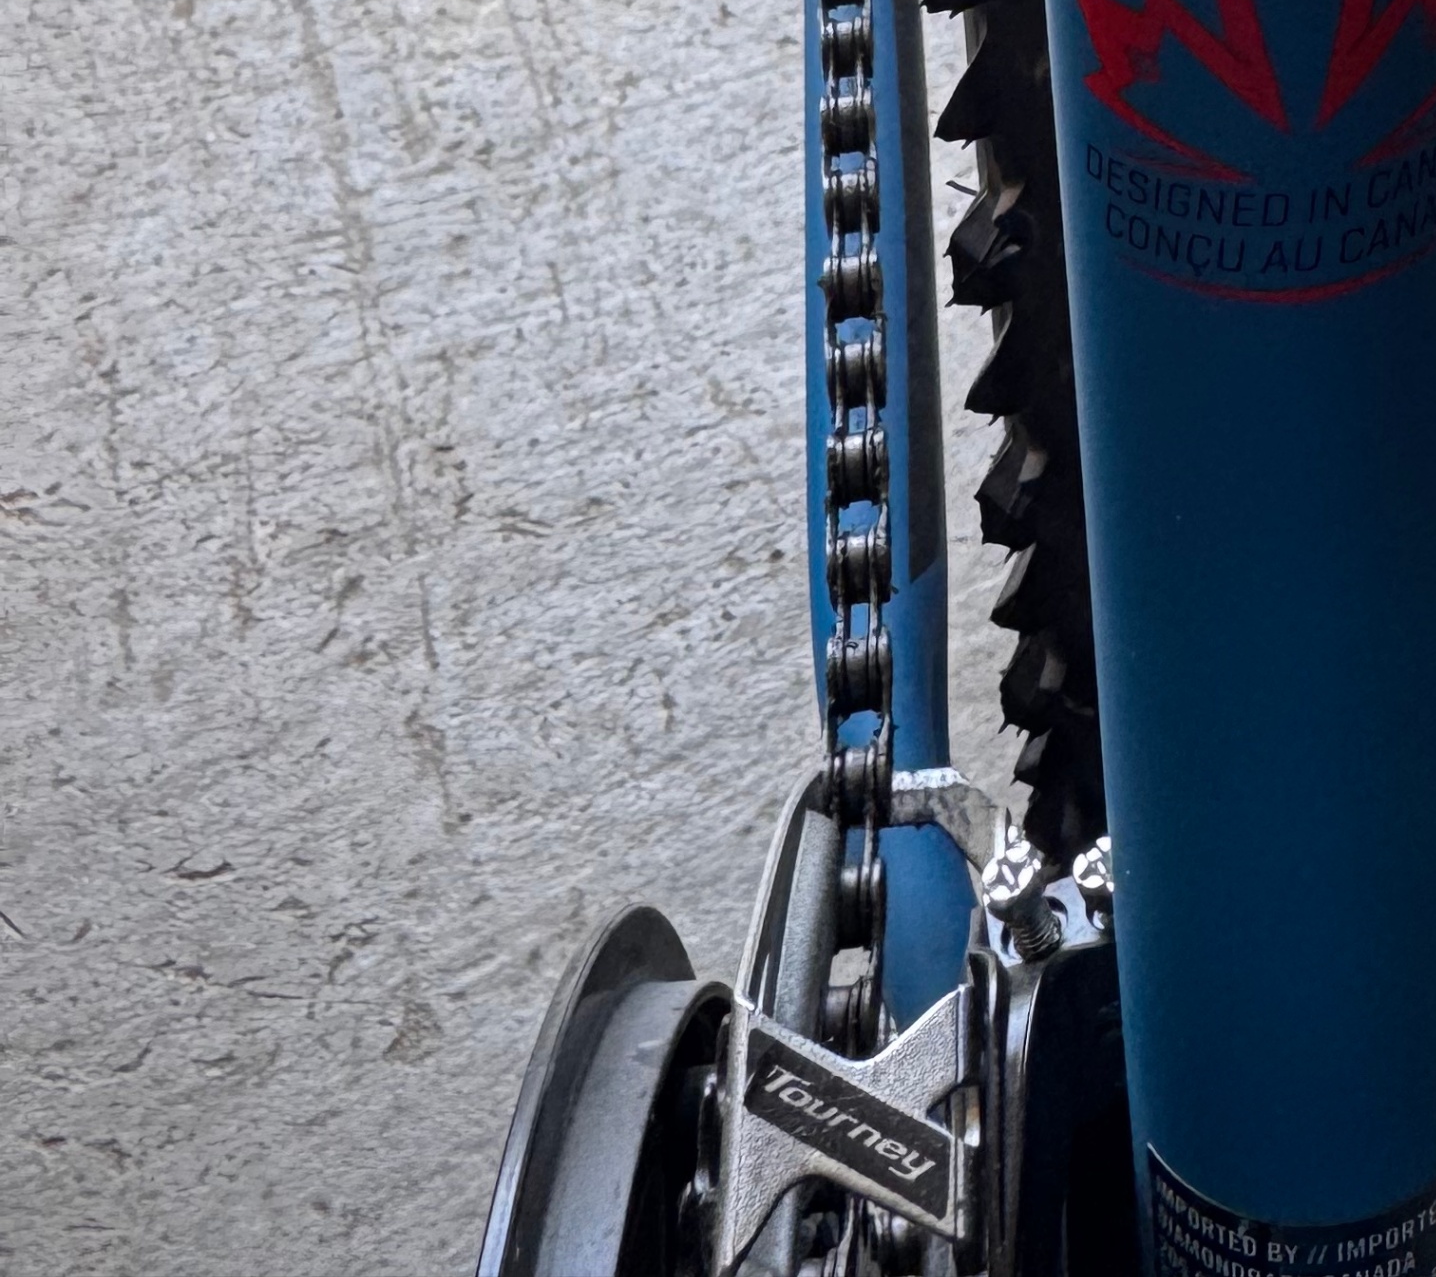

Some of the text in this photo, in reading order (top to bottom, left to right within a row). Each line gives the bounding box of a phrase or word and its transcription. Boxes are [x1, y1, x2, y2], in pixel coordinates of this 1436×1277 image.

[1087, 143, 1290, 228] DESIGNED
[1309, 183, 1352, 224] IN
[1106, 203, 1246, 277] CONÇU
[1259, 235, 1324, 274] AU
[764, 1064, 937, 1182] Tourney
[1267, 1241, 1298, 1265] BY
